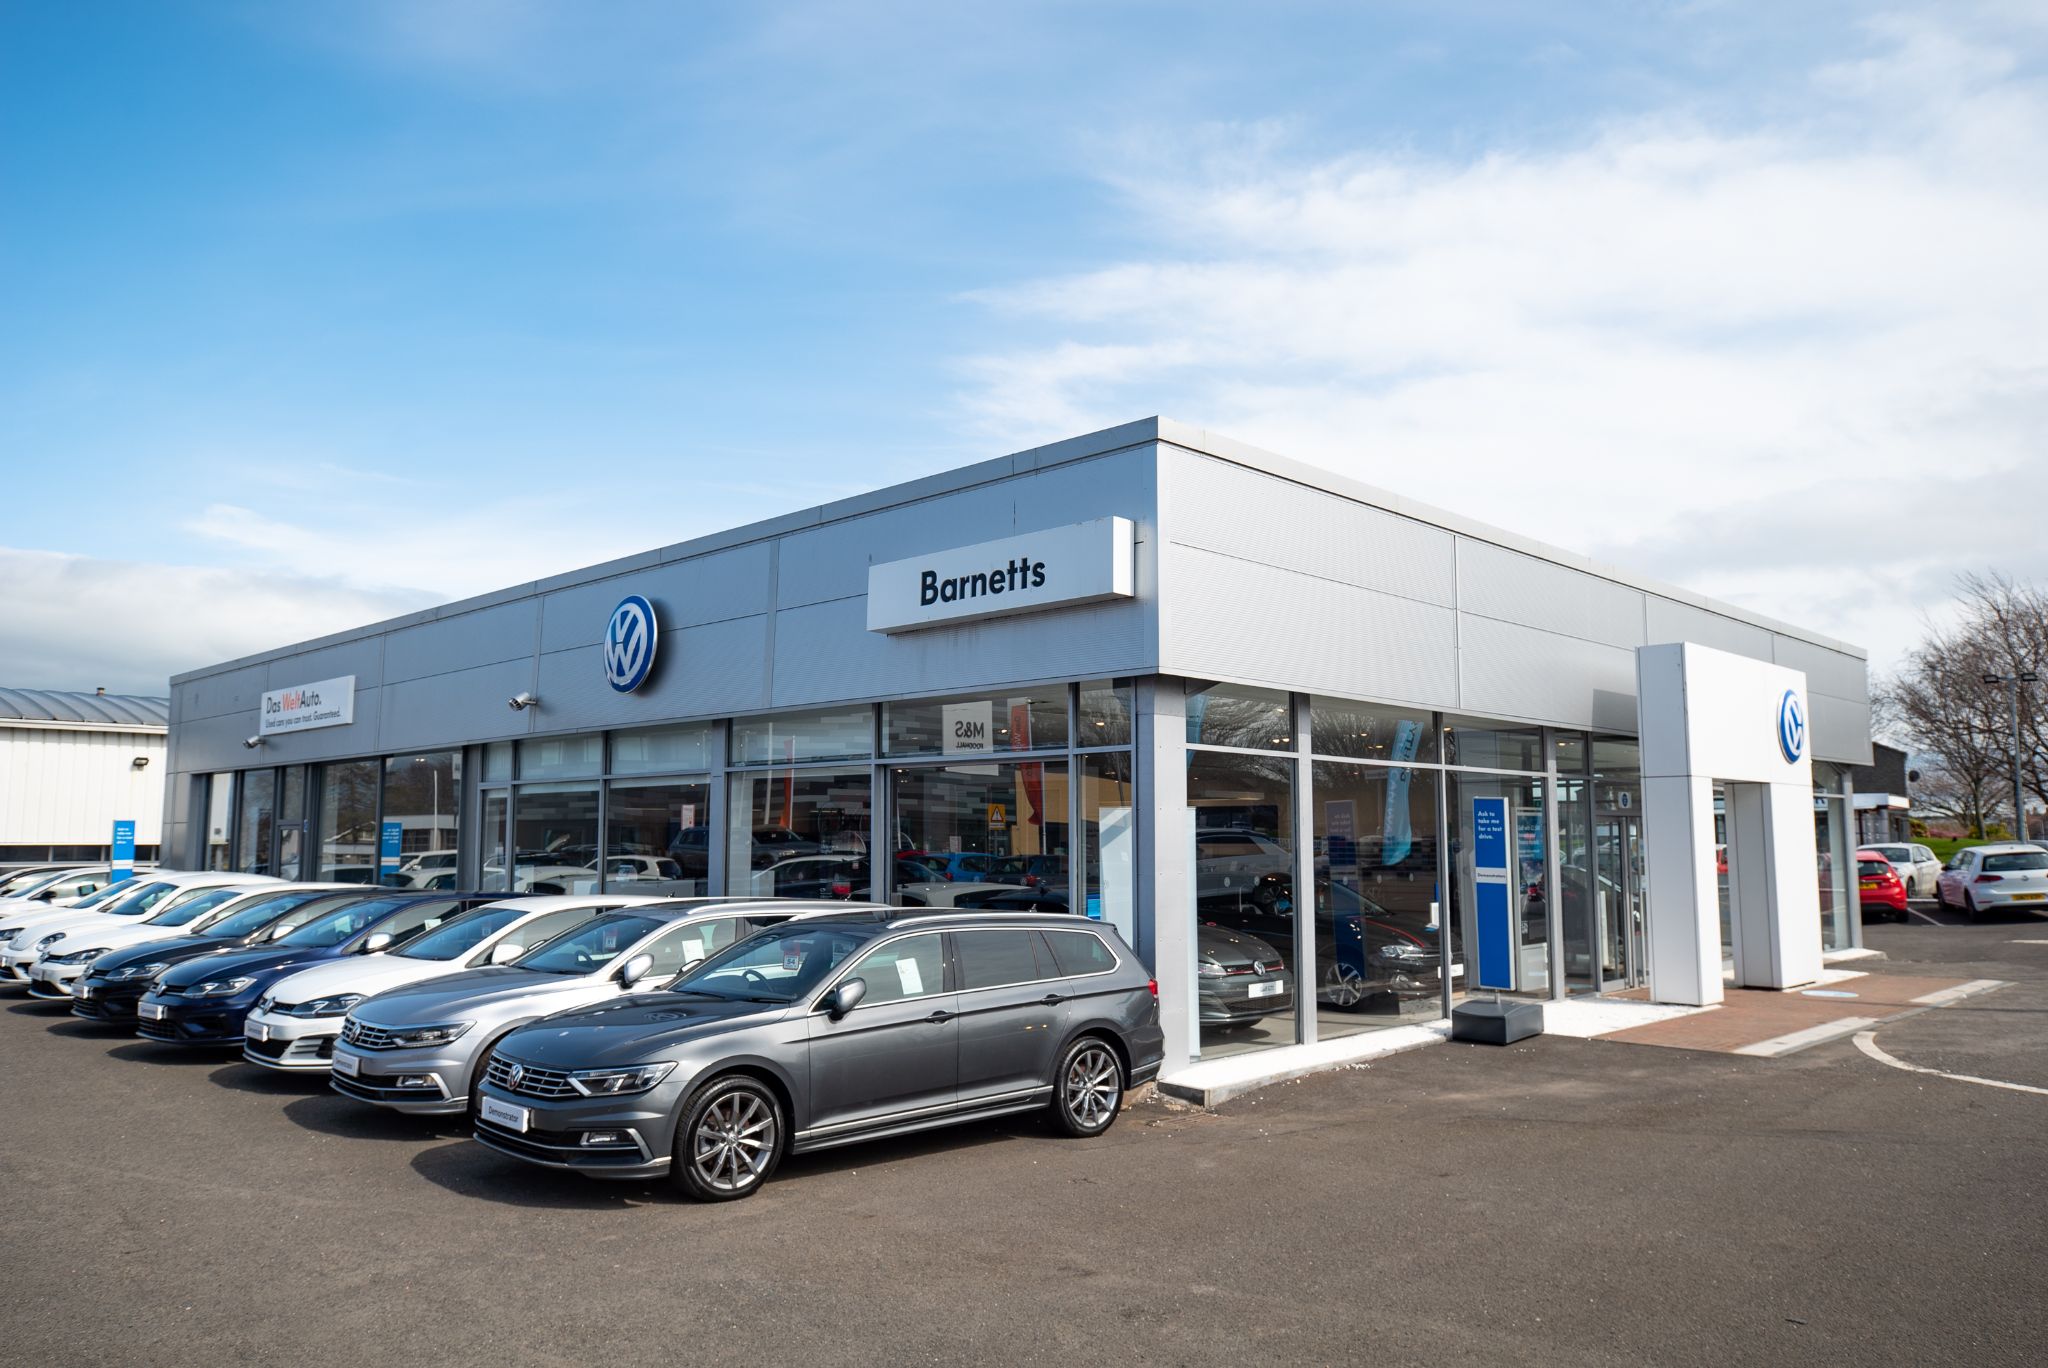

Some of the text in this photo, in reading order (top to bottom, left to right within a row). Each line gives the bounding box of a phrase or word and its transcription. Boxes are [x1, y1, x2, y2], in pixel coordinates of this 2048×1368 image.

[920, 556, 1046, 606] Barnetts
[266, 690, 322, 714] Das WeltAuto.
[488, 1105, 519, 1122] Demonstrator
